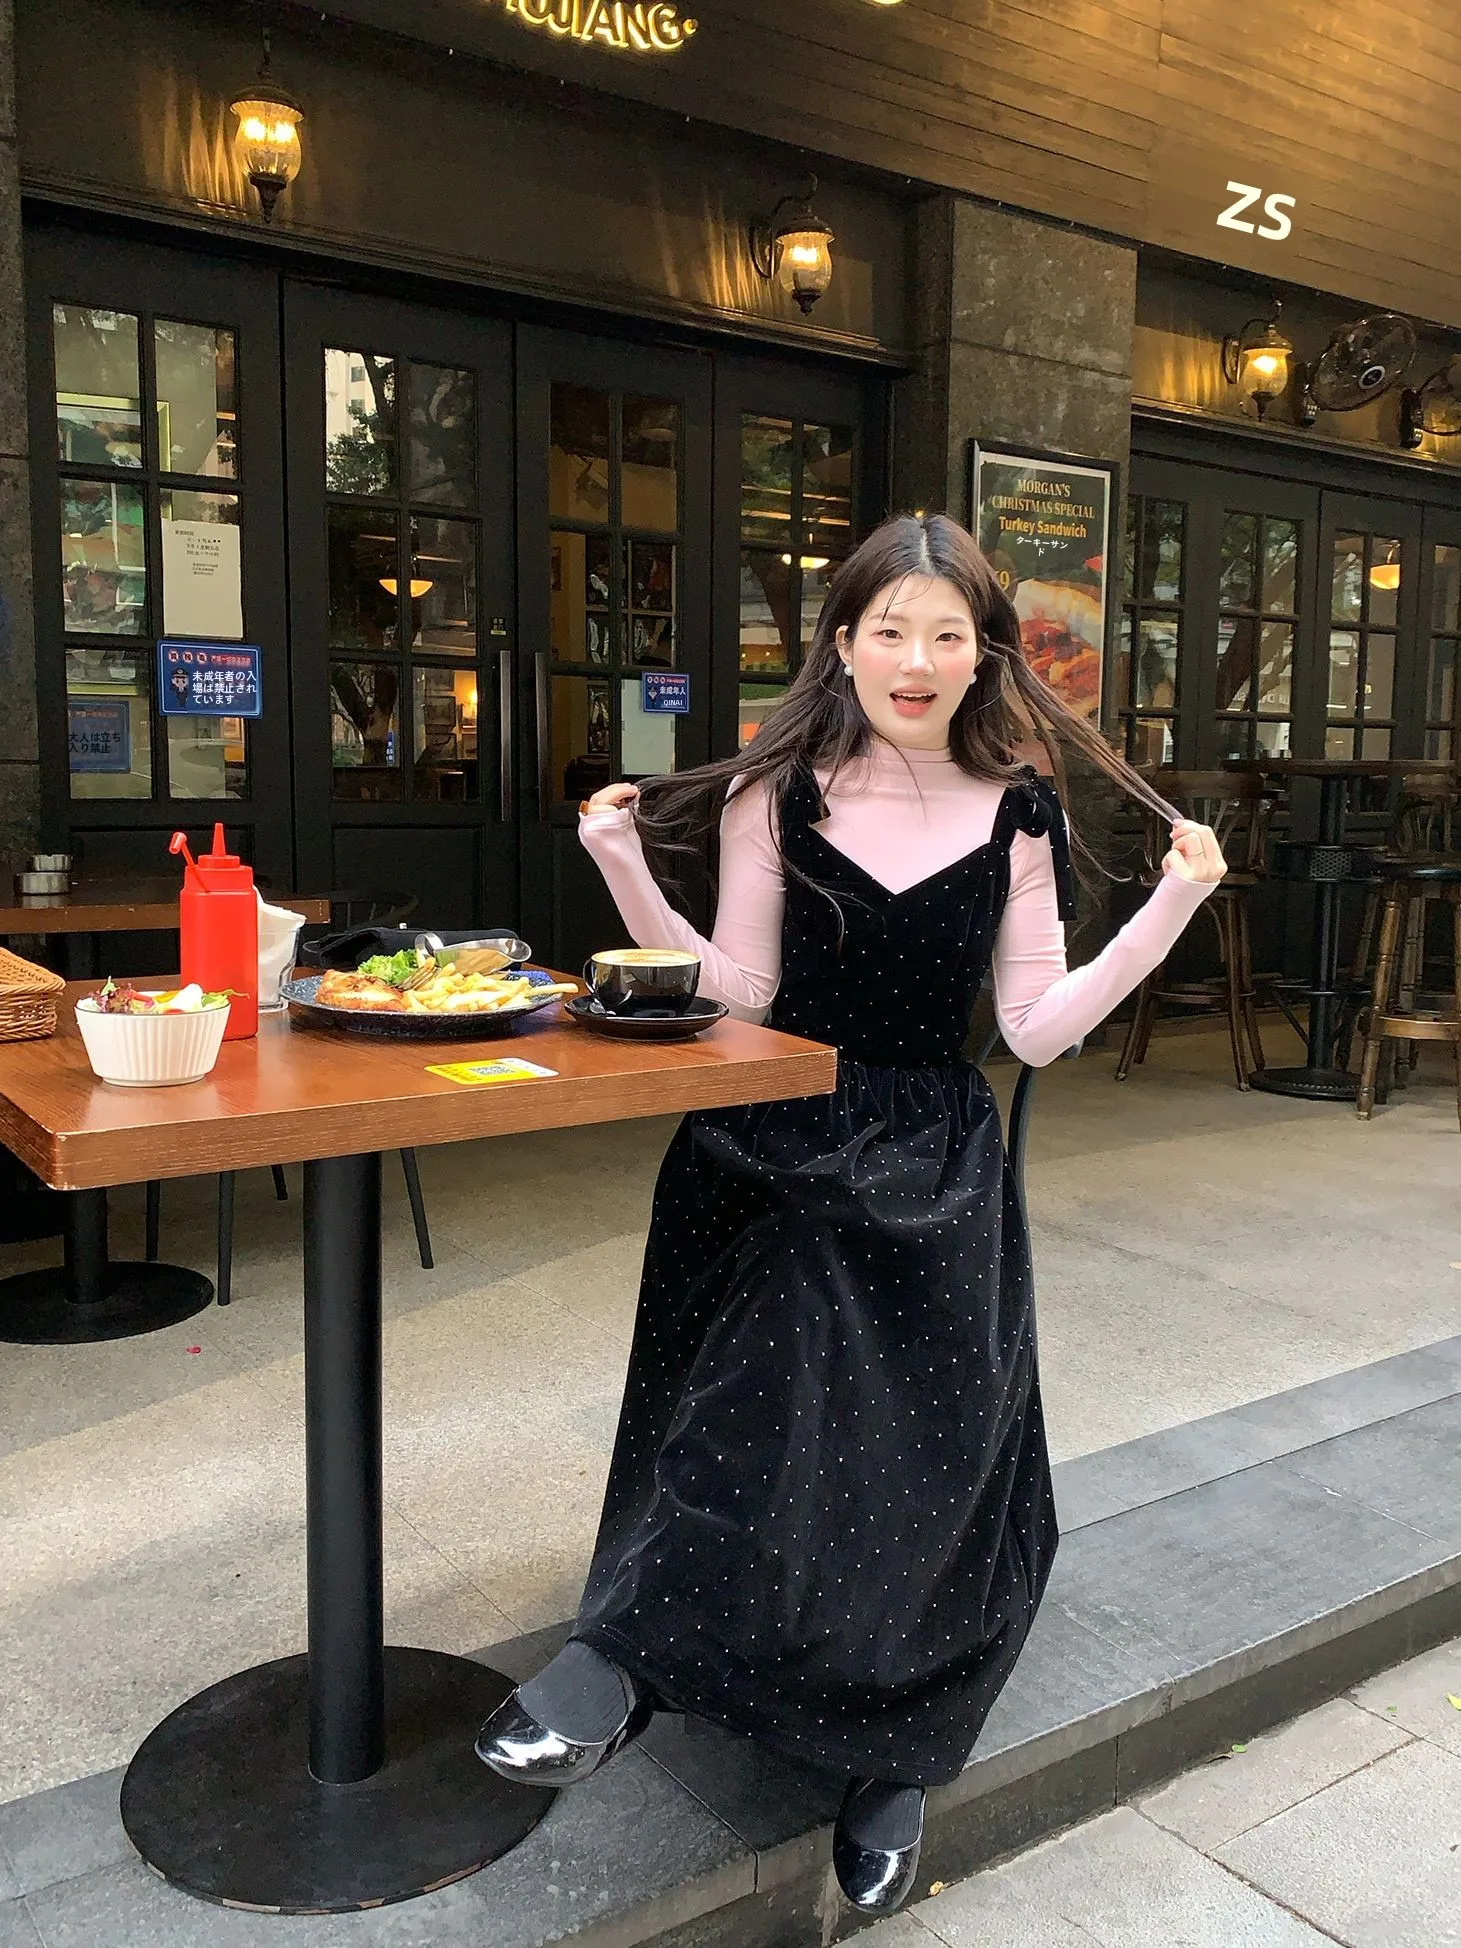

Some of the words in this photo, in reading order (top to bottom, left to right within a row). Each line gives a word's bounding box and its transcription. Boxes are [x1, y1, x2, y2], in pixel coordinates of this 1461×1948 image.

[1216, 180, 1297, 241] ZS
[1018, 479, 1071, 498] MORGAN'S
[992, 495, 1053, 514] CHRISTMAS
[1054, 502, 1095, 519] SPECIAL
[999, 516, 1035, 535] Turkey
[1037, 521, 1087, 538] Sandwich
[1016, 536, 1068, 549] ターキーサン
[192, 670, 257, 682] 未成年者の入
[192, 682, 258, 694] 場は禁止され
[192, 694, 235, 705] ています
[68, 731, 121, 743] 大人は立ち
[69, 742, 112, 754] 入り禁止
